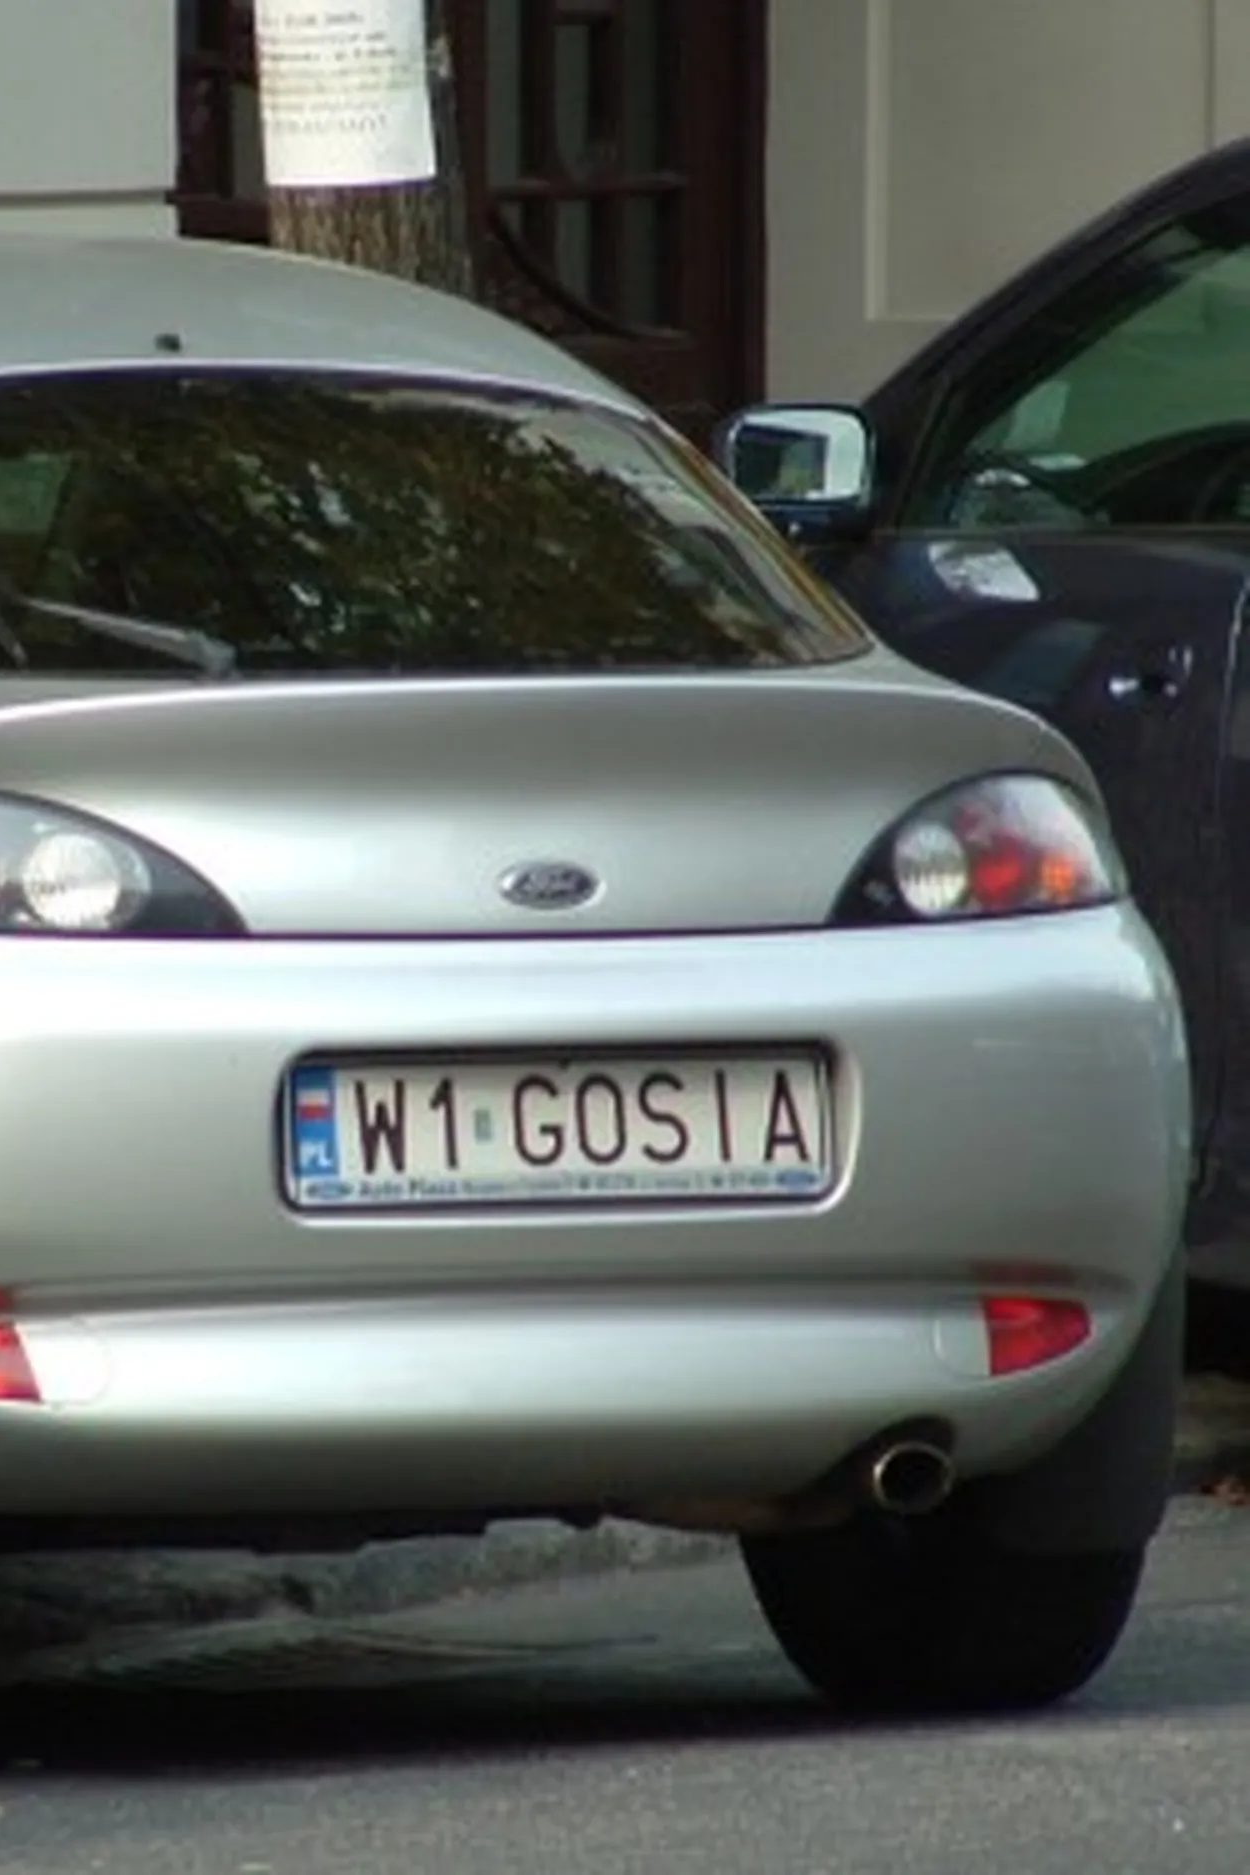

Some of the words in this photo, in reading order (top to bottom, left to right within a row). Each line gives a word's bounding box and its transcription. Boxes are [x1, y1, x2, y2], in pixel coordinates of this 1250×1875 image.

[298, 1141, 332, 1168] PL
[354, 1077, 459, 1174] W1
[512, 1069, 810, 1166] GOSIA
